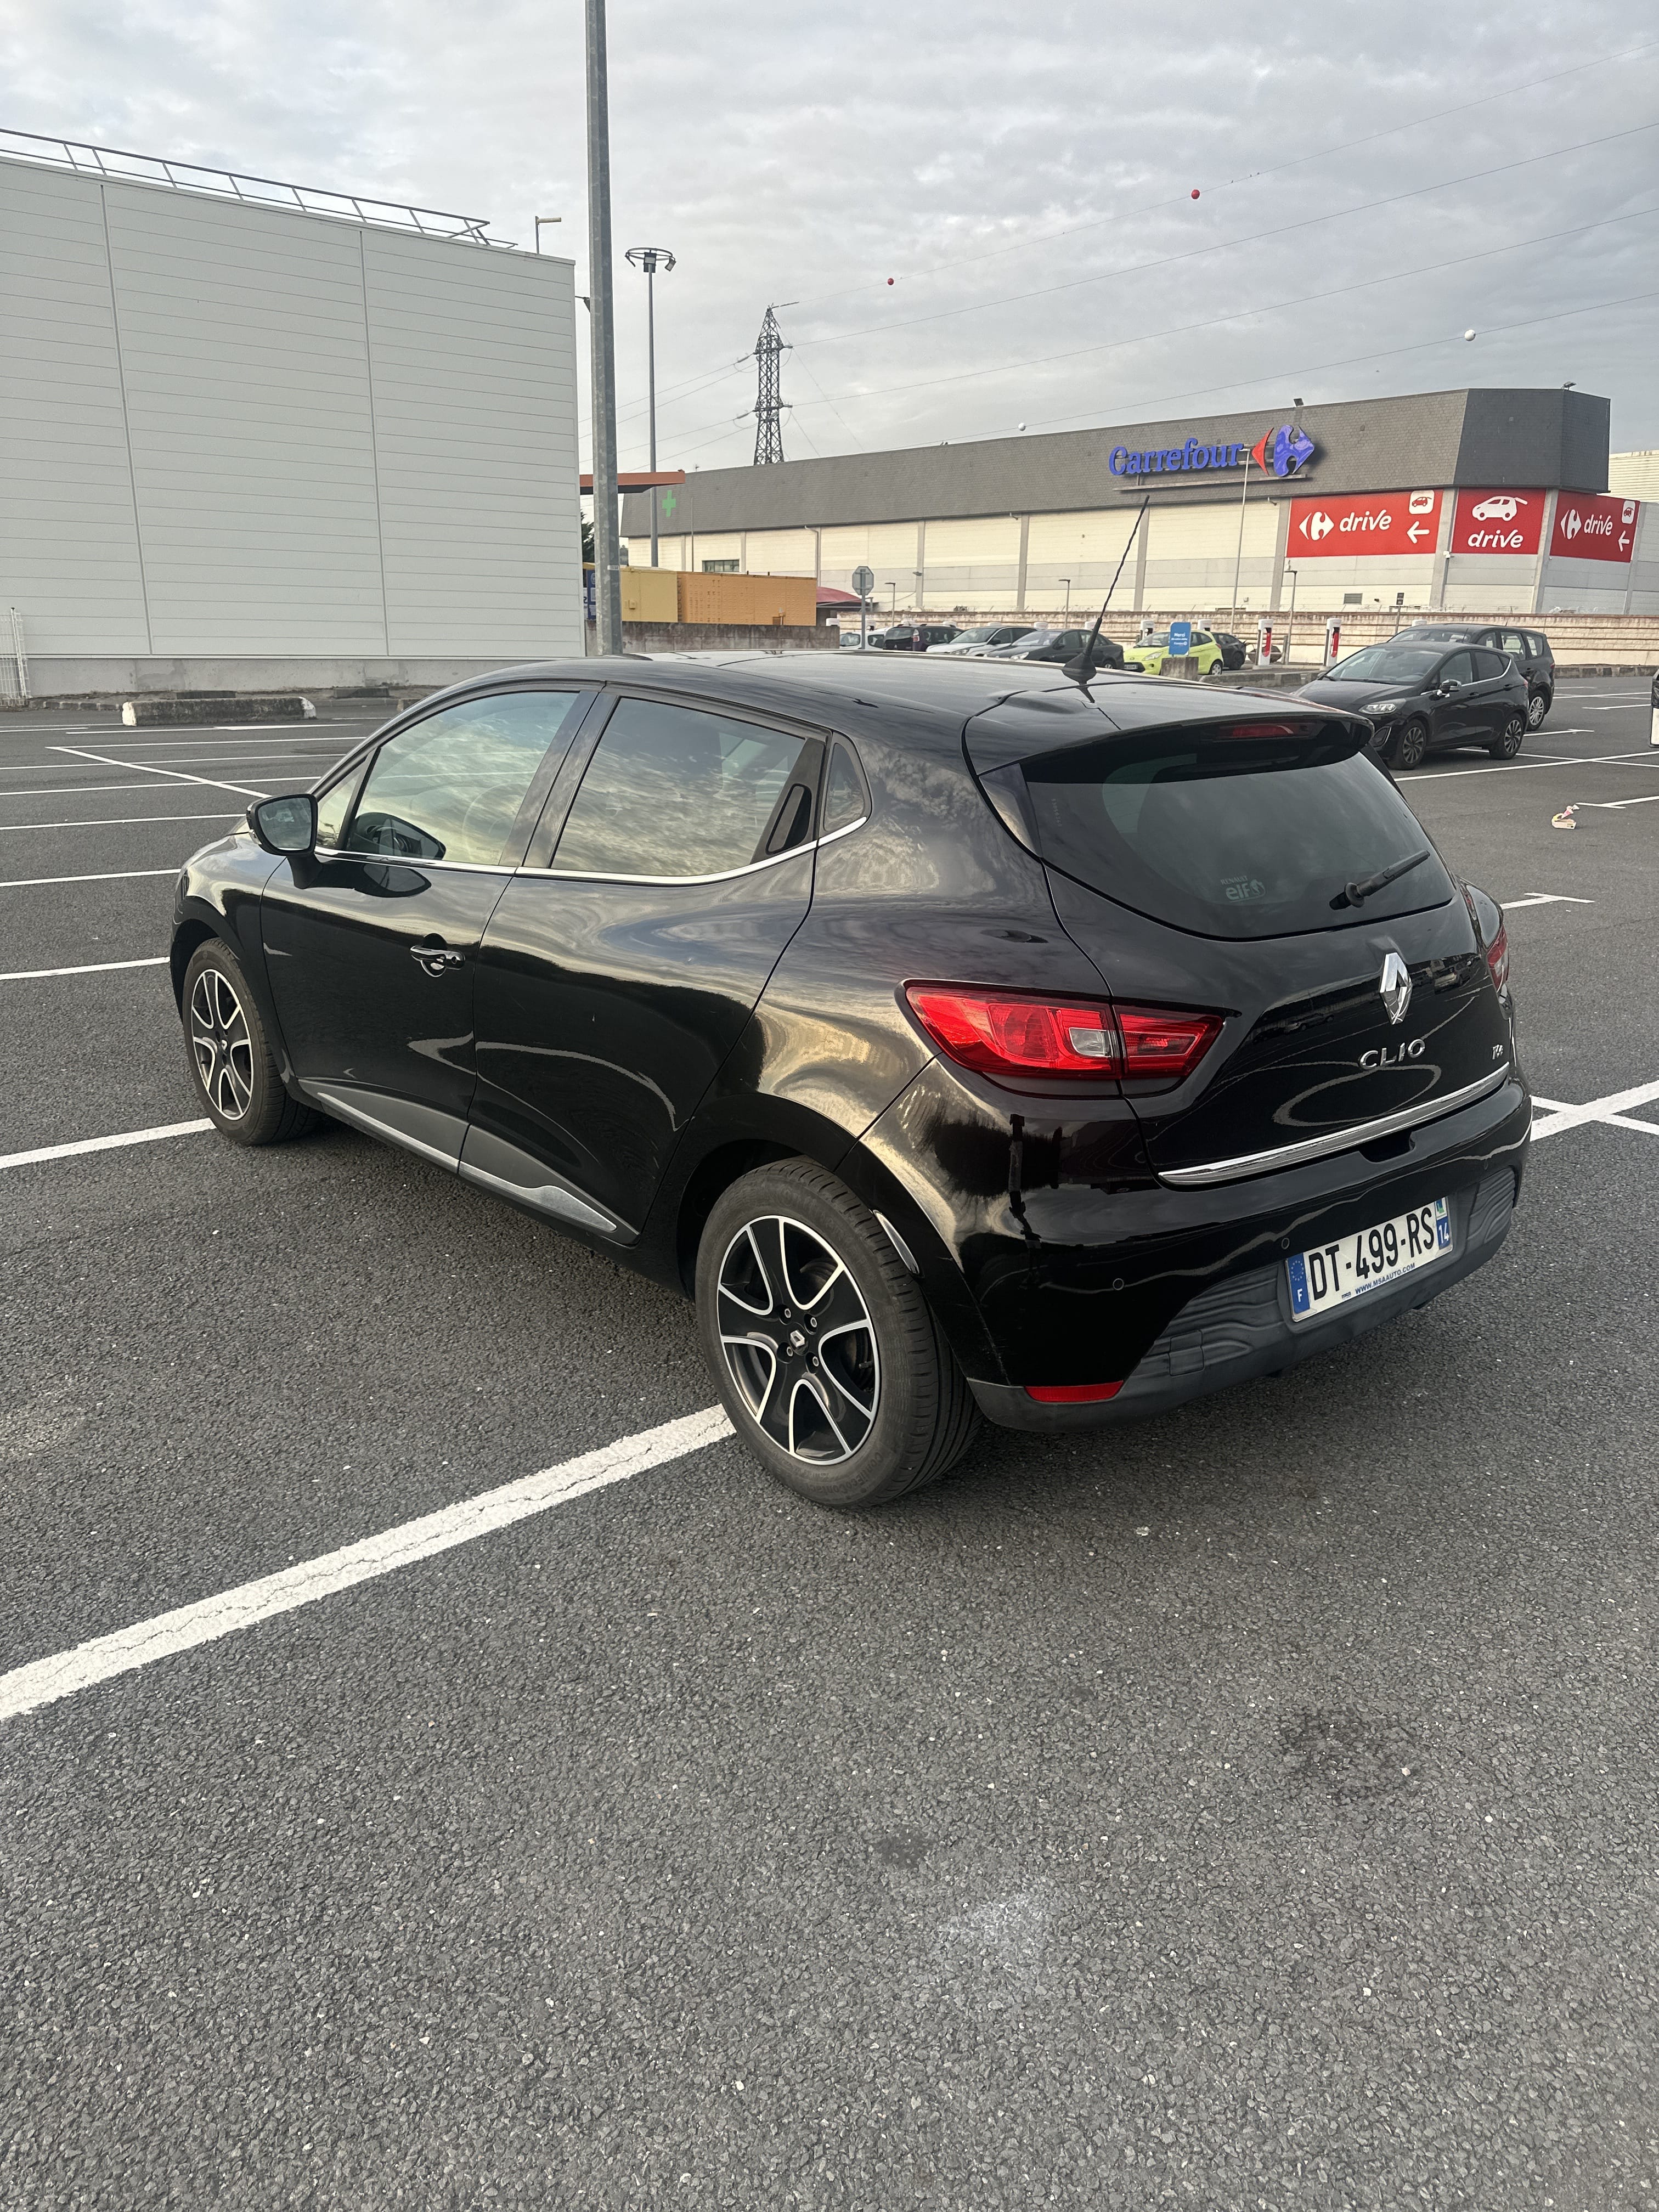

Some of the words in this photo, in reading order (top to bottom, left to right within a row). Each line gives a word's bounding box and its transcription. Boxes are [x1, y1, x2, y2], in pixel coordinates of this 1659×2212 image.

[1109, 437, 1244, 476] Carrefour
[1339, 509, 1392, 532] drive
[1584, 514, 1613, 535] drive
[1468, 529, 1523, 548] drive
[1220, 875, 1248, 885] RENAULT
[1226, 883, 1250, 900] elf
[1359, 1038, 1425, 1068] CLIO
[1438, 1222, 1449, 1244] 14
[1308, 1207, 1435, 1301] DT-499-RS
[1355, 1262, 1415, 1295] WWW.MSAAUTO.COM
[1297, 1288, 1303, 1302] F
